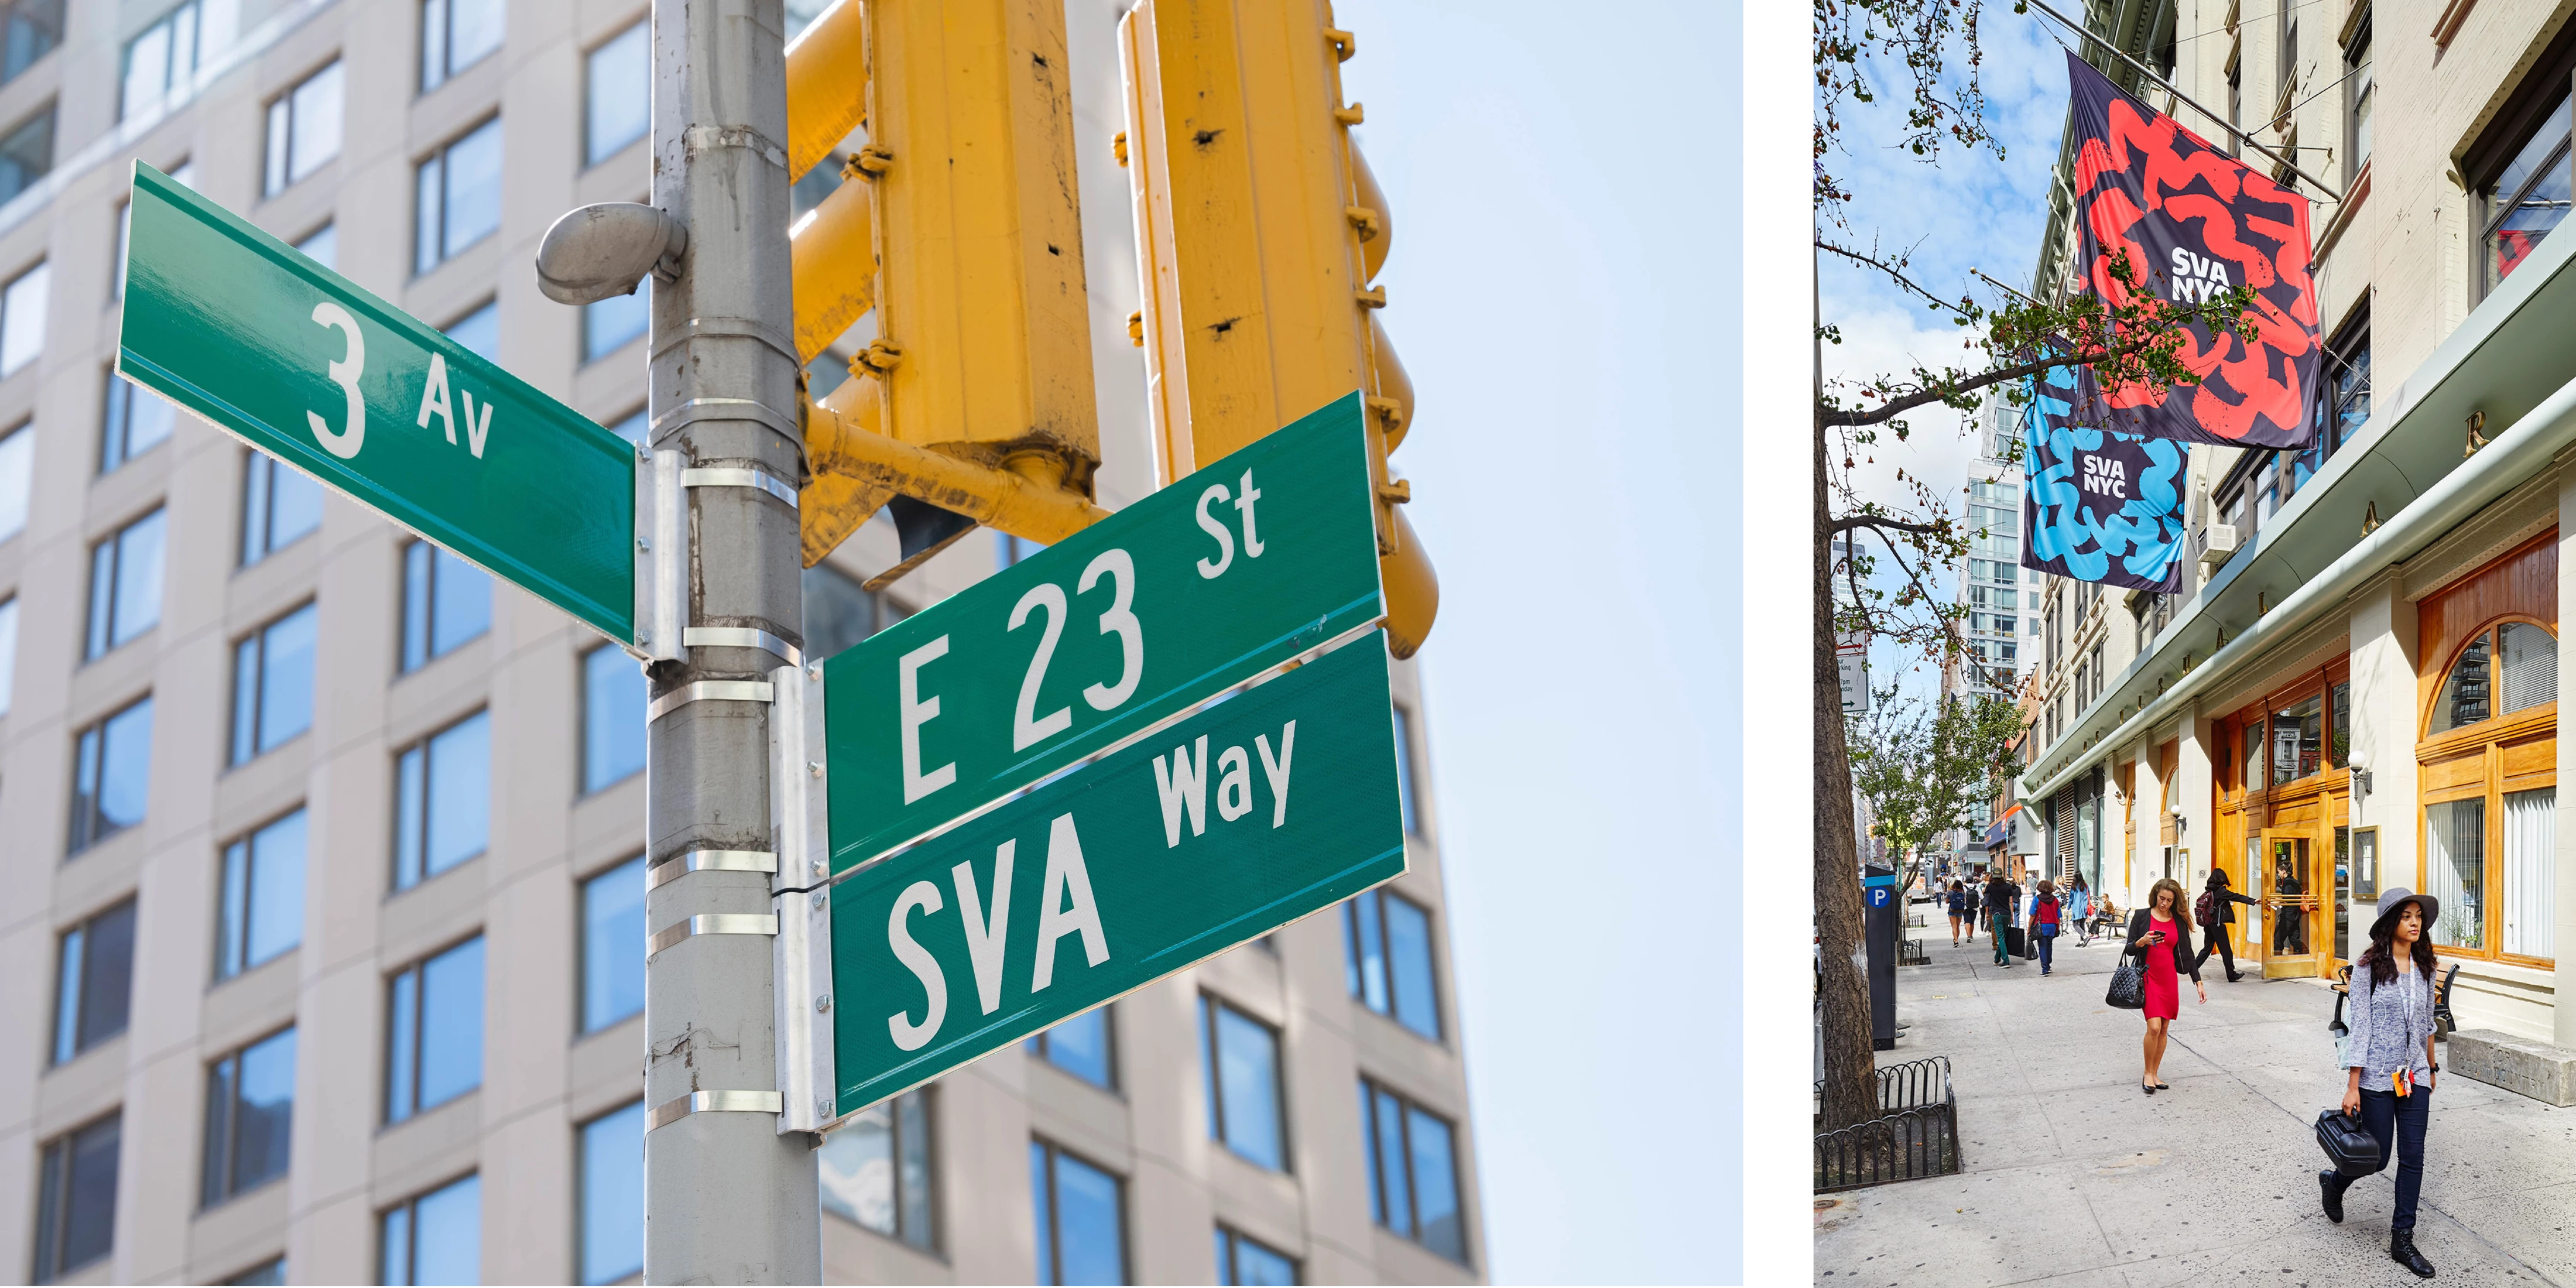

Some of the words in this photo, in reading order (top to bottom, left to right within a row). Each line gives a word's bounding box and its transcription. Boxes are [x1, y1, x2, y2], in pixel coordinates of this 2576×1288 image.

[2171, 246, 2230, 287] SVA
[307, 302, 365, 459] 3
[417, 352, 493, 459] Av
[2084, 454, 2125, 480] SVA
[2084, 473, 2126, 499] NYC
[899, 634, 956, 805] E
[1007, 549, 1143, 753] 23
[1195, 467, 1265, 579] St
[888, 812, 1110, 1051] SVA
[1152, 719, 1296, 848] Way
[1875, 889, 1886, 905] P
